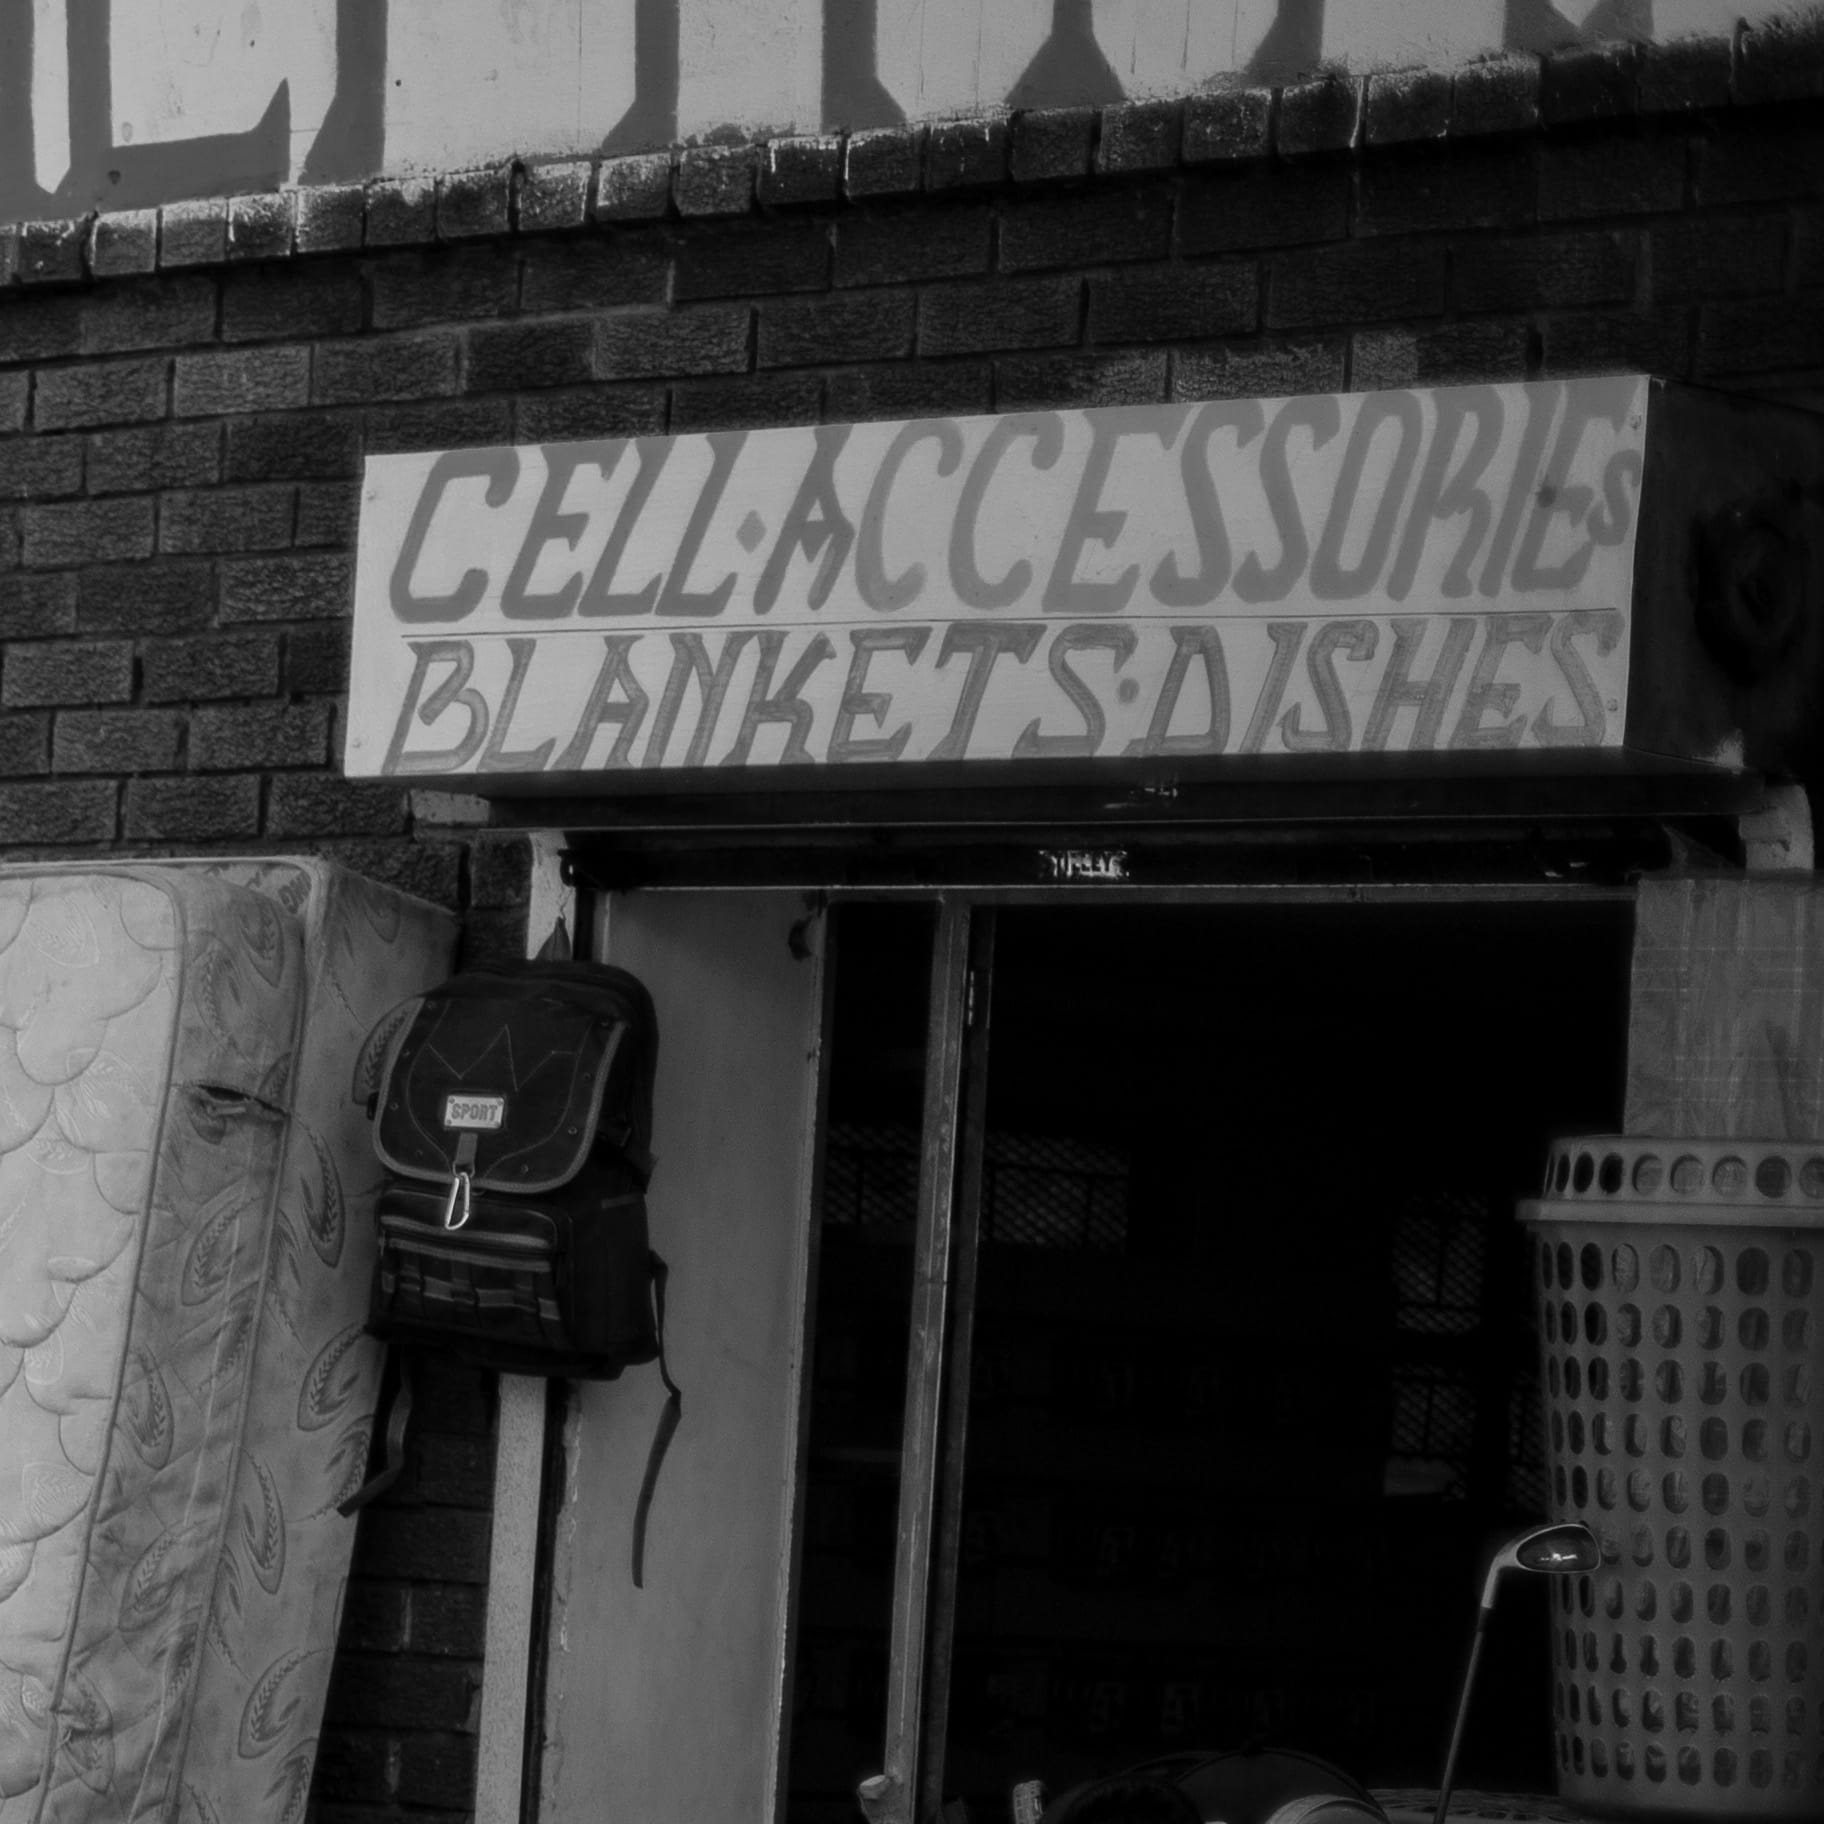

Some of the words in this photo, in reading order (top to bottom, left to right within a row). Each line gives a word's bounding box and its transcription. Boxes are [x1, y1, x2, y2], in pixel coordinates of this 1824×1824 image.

[389, 437, 738, 622] CELL
[755, 380, 1644, 613] ACCESSORIES
[381, 620, 1136, 778] BLANKETS
[1136, 607, 1624, 757] DISHES
[451, 1103, 498, 1123] SPORT
